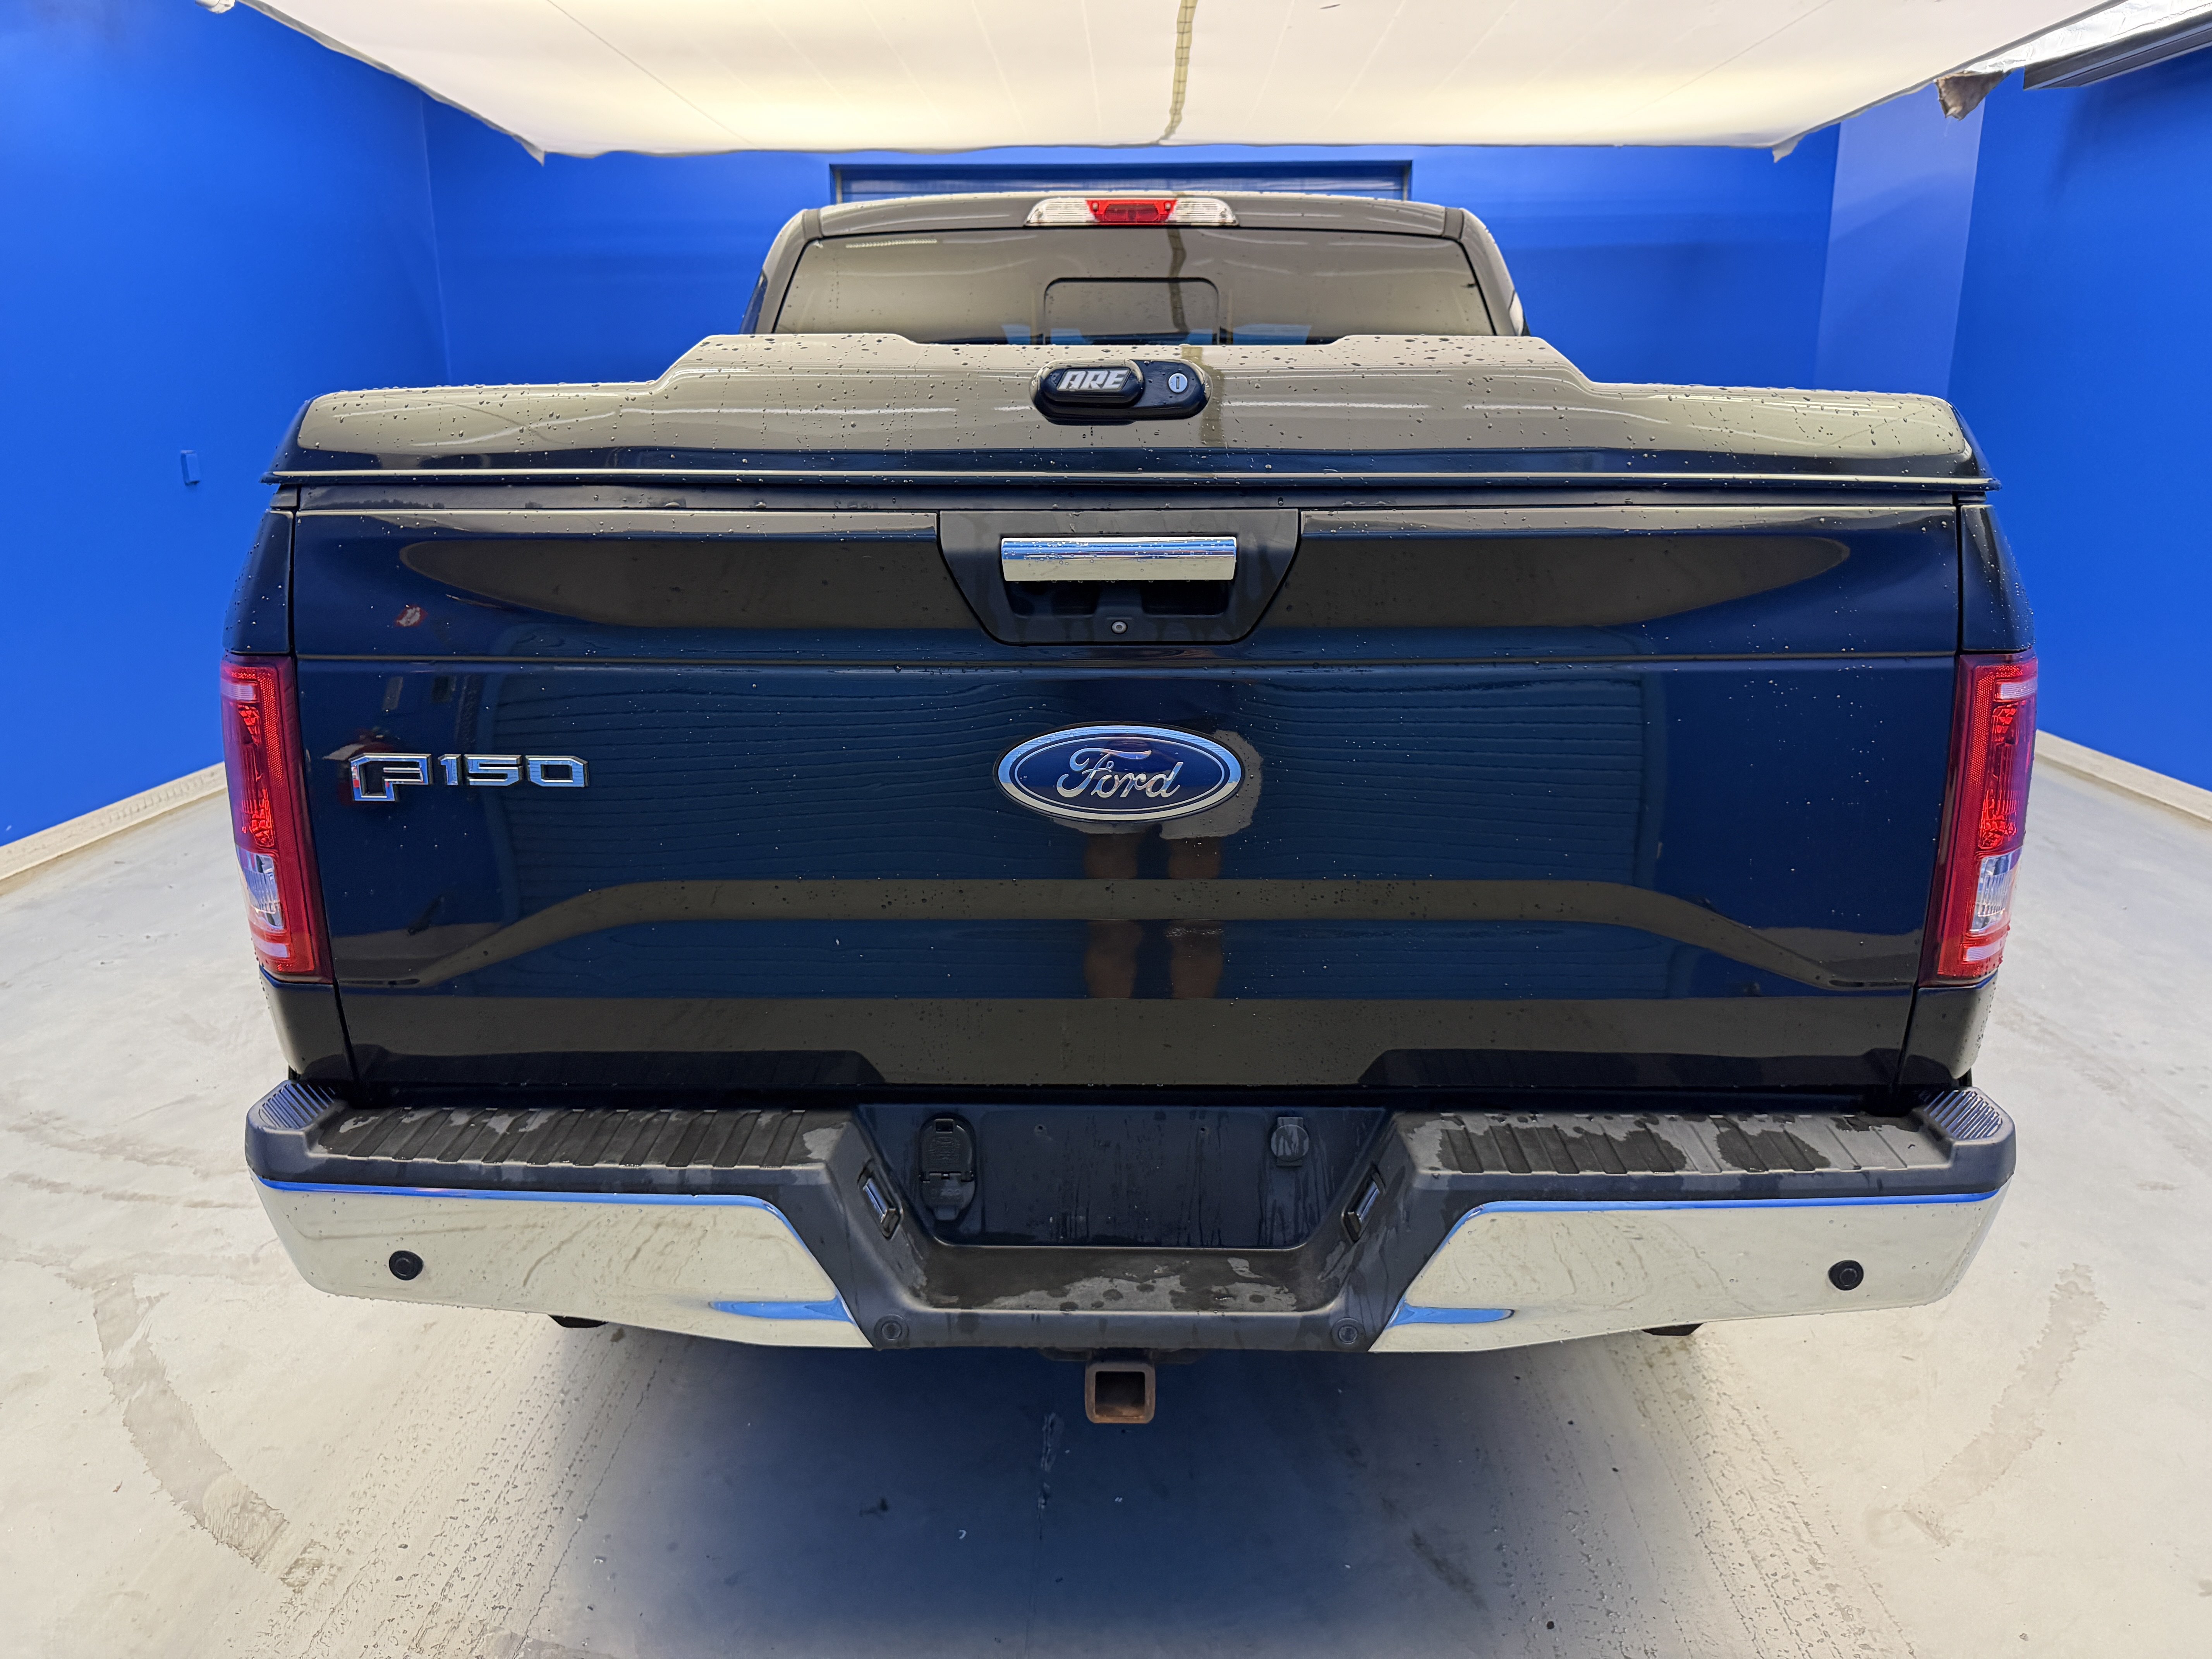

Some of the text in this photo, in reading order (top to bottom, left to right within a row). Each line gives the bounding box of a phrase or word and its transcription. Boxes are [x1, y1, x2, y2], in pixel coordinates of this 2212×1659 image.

[1057, 370, 1128, 390] ARE
[349, 752, 589, 802] F150
[1056, 747, 1184, 798] Ford
